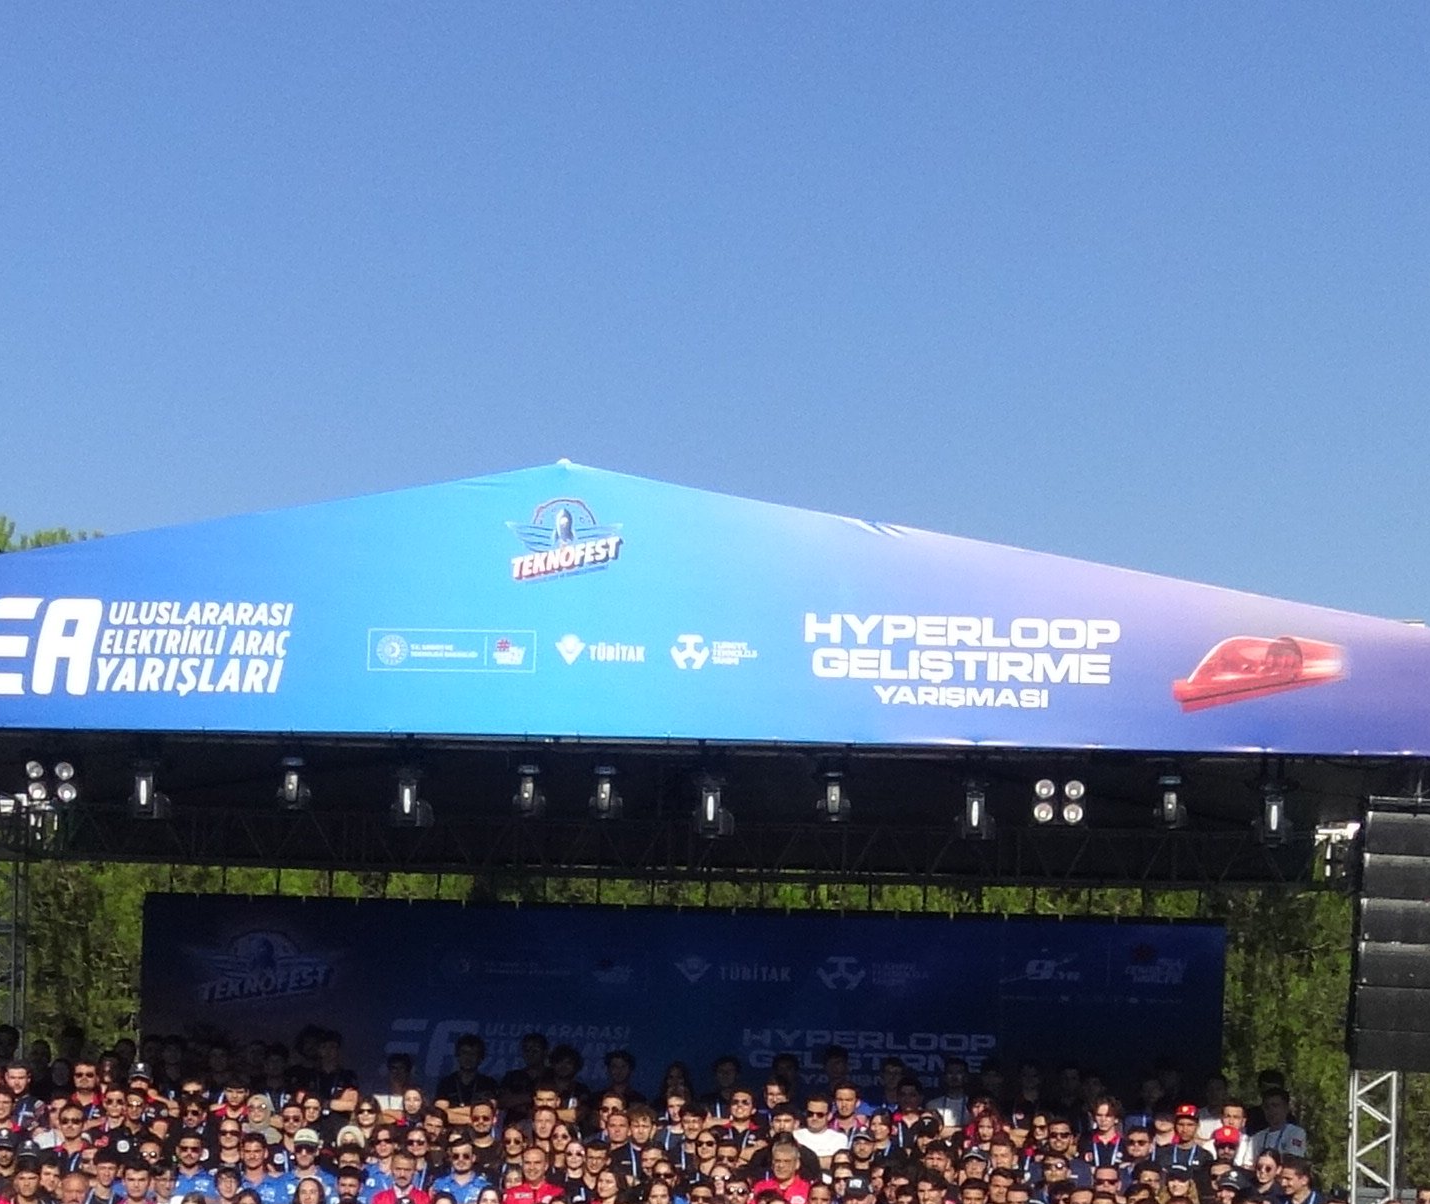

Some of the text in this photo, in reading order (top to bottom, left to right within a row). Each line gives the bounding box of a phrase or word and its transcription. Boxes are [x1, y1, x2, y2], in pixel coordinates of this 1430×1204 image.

[511, 535, 624, 580] TEKNOFEST
[108, 601, 294, 627] ULUSLARARASI
[100, 625, 291, 657] ELEKTRİKLİ ARAÇ
[803, 613, 1122, 649] HYPERLOOP
[589, 641, 646, 662] TÜBİTAK
[97, 657, 284, 697] YARIŞLARI
[873, 685, 1049, 708] YARIŞMASI
[198, 964, 335, 1002] TEKNOFEST
[718, 964, 792, 983] TÜBİTAK
[742, 1028, 997, 1051] HYPERLOOP
